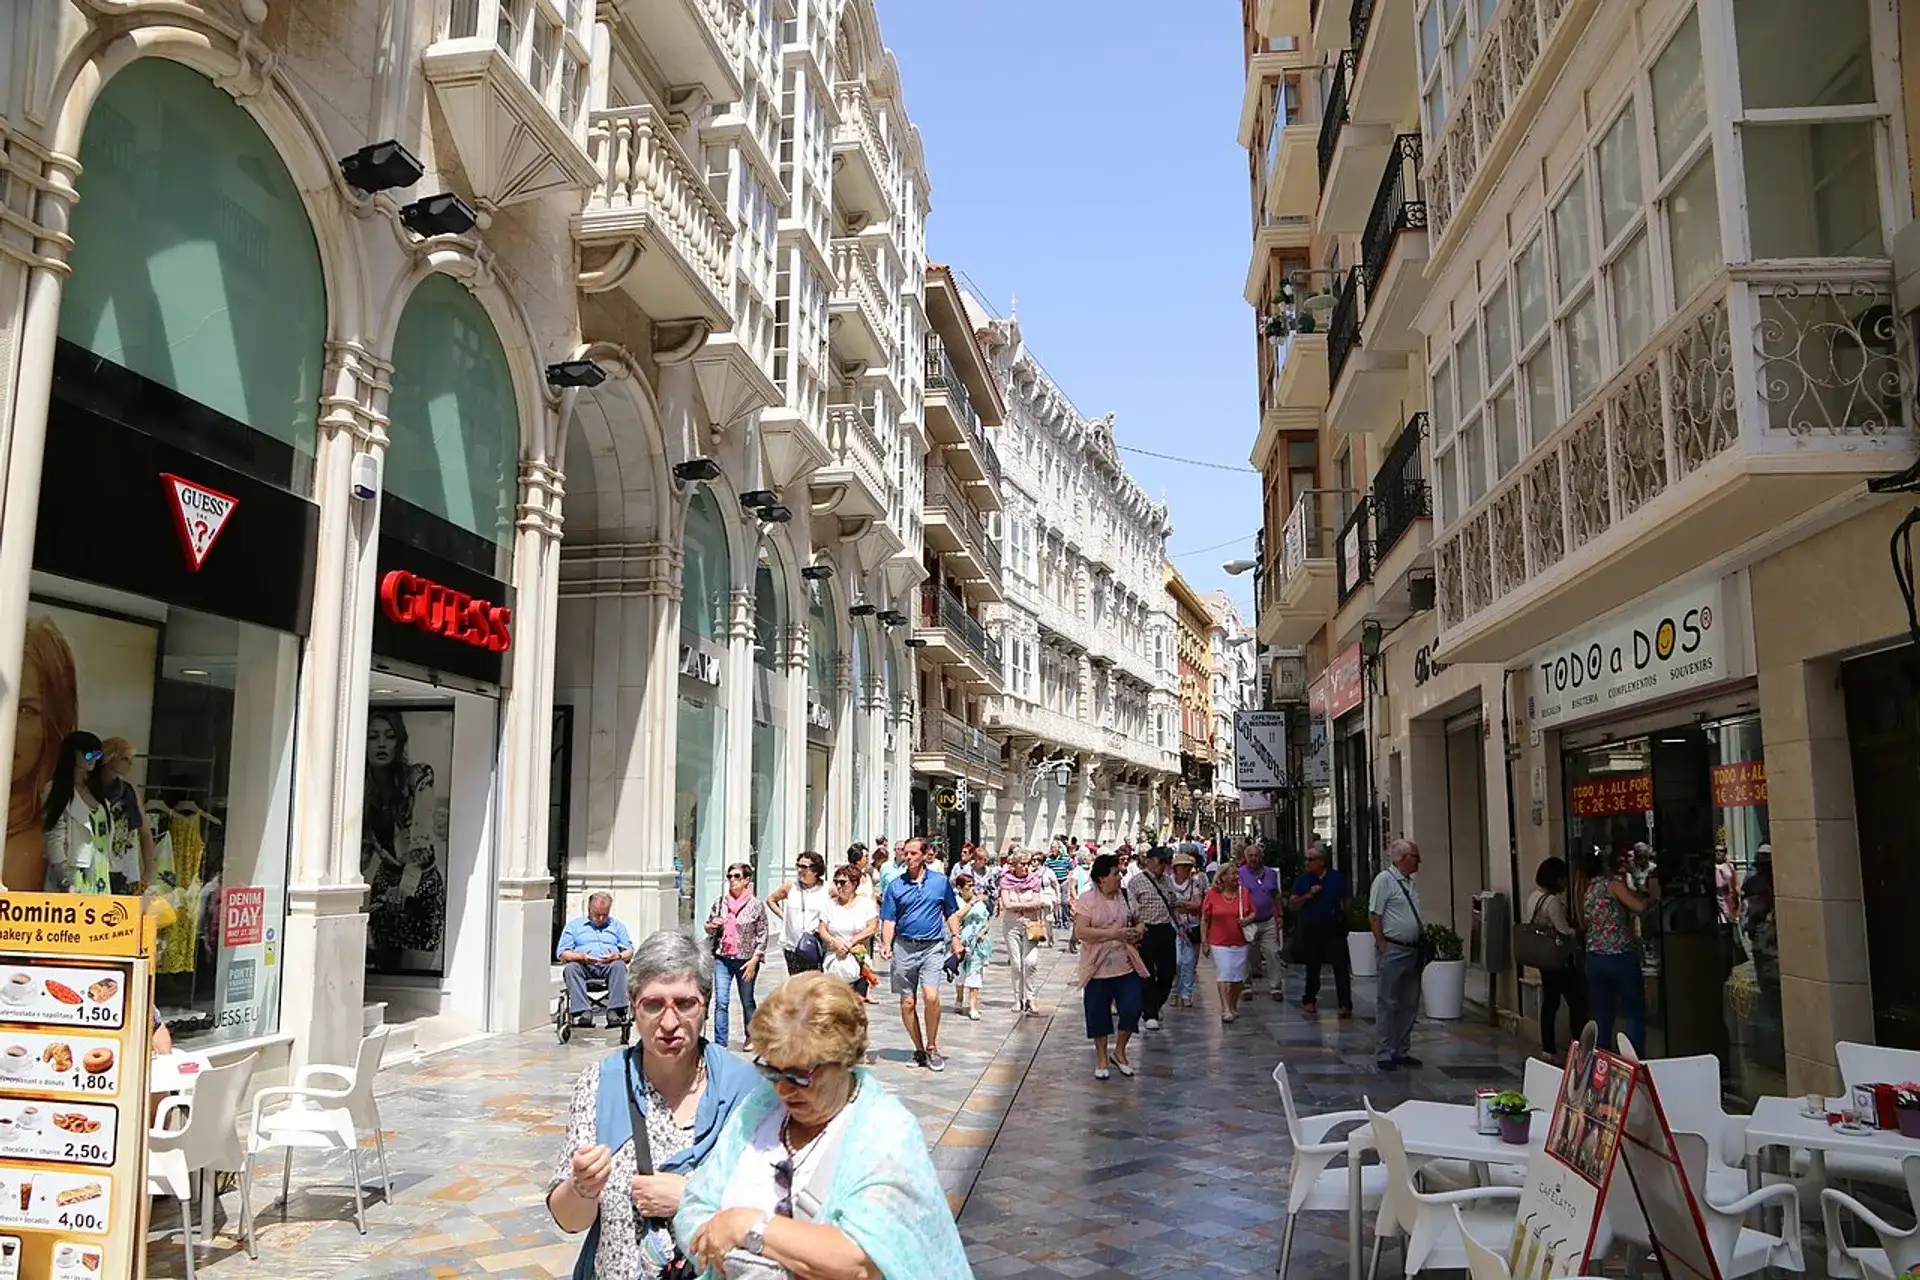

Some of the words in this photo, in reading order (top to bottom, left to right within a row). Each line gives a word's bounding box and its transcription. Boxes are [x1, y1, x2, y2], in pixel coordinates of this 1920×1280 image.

[181, 487, 224, 517] GUESS
[381, 570, 512, 652] GUESS
[1540, 643, 1602, 694] TODO
[1610, 647, 1623, 674] a
[1607, 674, 1658, 699] COMPLEMENTOS
[1669, 657, 1713, 681] SOUVENIRS
[1713, 768, 1736, 785] TODO
[1740, 767, 1748, 782] A
[1572, 785, 1595, 799] TODO
[1598, 783, 1605, 796] A
[1610, 779, 1628, 795] ALL
[1629, 776, 1650, 792] FOR
[940, 795, 956, 804] IN
[229, 892, 261, 906] DENIM
[228, 906, 261, 928] DAY
[35, 929, 43, 942] &
[46, 929, 81, 943] coffee
[89, 935, 110, 943] TAKE
[112, 928, 135, 938] AWAY
[76, 1006, 119, 1022] 1,50€
[72, 1073, 115, 1091] 1,80€
[64, 1143, 108, 1160] 2,50€
[58, 1212, 103, 1230] 4,00€
